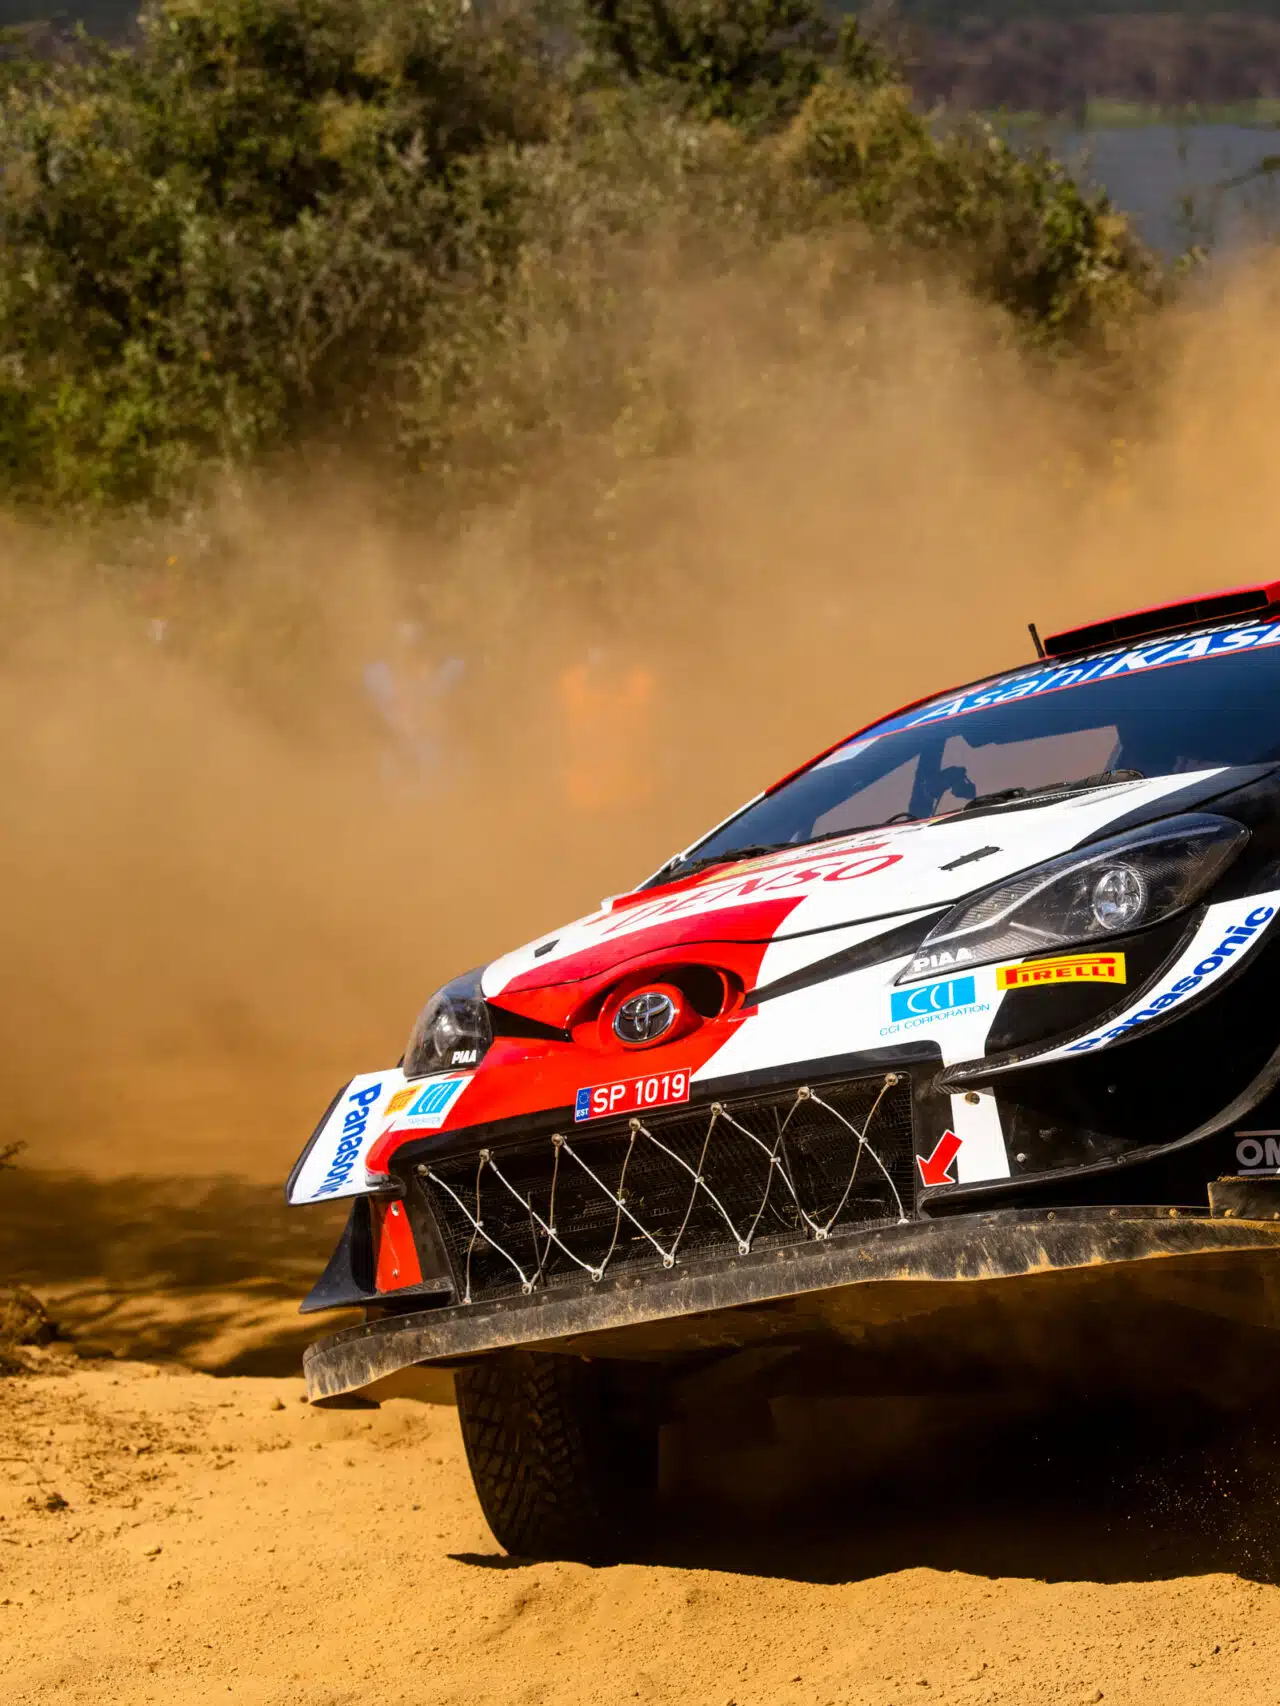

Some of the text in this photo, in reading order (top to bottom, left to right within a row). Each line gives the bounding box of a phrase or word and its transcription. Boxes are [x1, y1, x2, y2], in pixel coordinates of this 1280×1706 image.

[600, 854, 904, 936] DENSO
[912, 947, 974, 973] PIAA
[1005, 956, 1116, 985] PIRELLI
[1063, 905, 1275, 1052] Panasonic
[906, 981, 955, 1014] CCI
[879, 1002, 991, 1037] CCI CORPORATION
[451, 1049, 477, 1065] PIAA
[592, 1073, 686, 1113] SP 1019
[576, 1107, 590, 1118] EST
[310, 1081, 383, 1199] Panasonic
